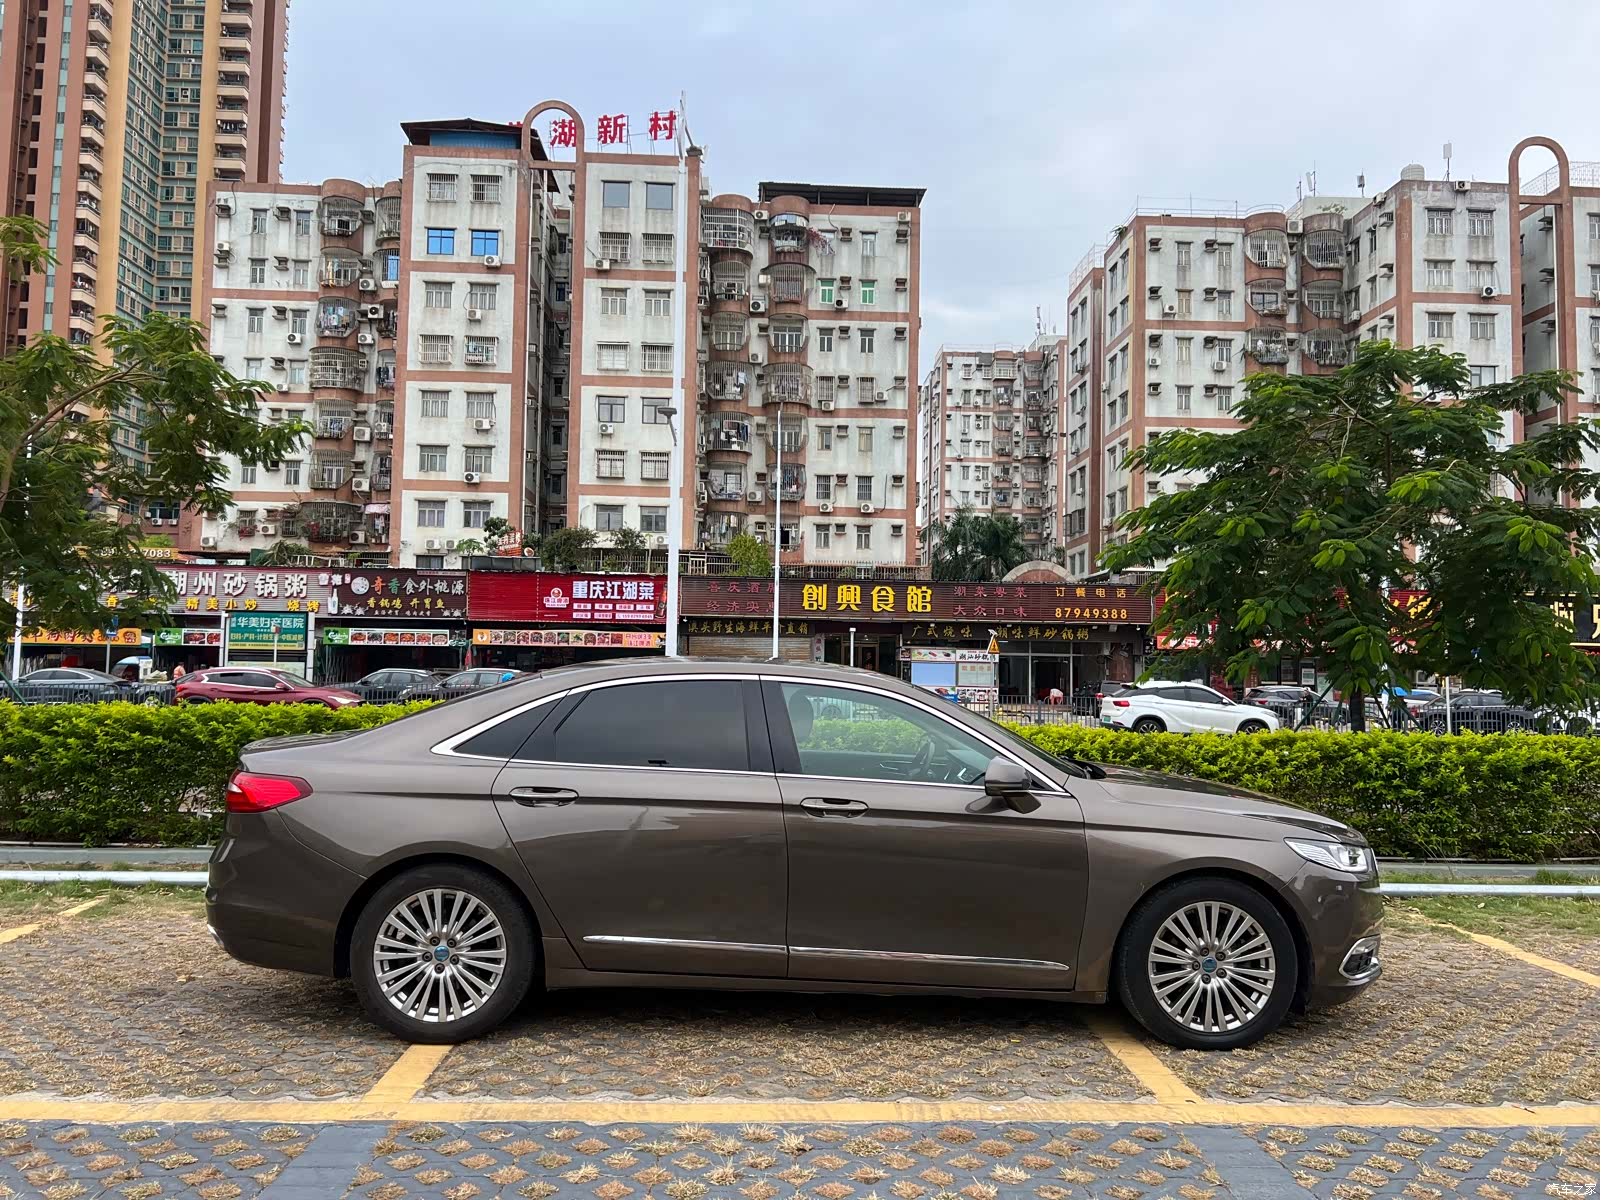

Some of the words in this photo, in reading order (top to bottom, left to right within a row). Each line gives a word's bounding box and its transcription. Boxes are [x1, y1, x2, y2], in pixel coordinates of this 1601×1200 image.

[572, 580, 655, 600] 重庆江湖菜
[953, 586, 1028, 598] 潮菜粤菜
[1055, 587, 1128, 598] 订餐电话
[186, 597, 257, 611] 精美小炒
[801, 583, 933, 613] 創興食館
[287, 600, 321, 613] 烧烤
[953, 604, 1028, 617] 大众口味
[1055, 608, 1128, 619] 87949388
[237, 616, 304, 629] 华美妇产医院
[688, 622, 809, 635] 澳头野生海鲜平直销
